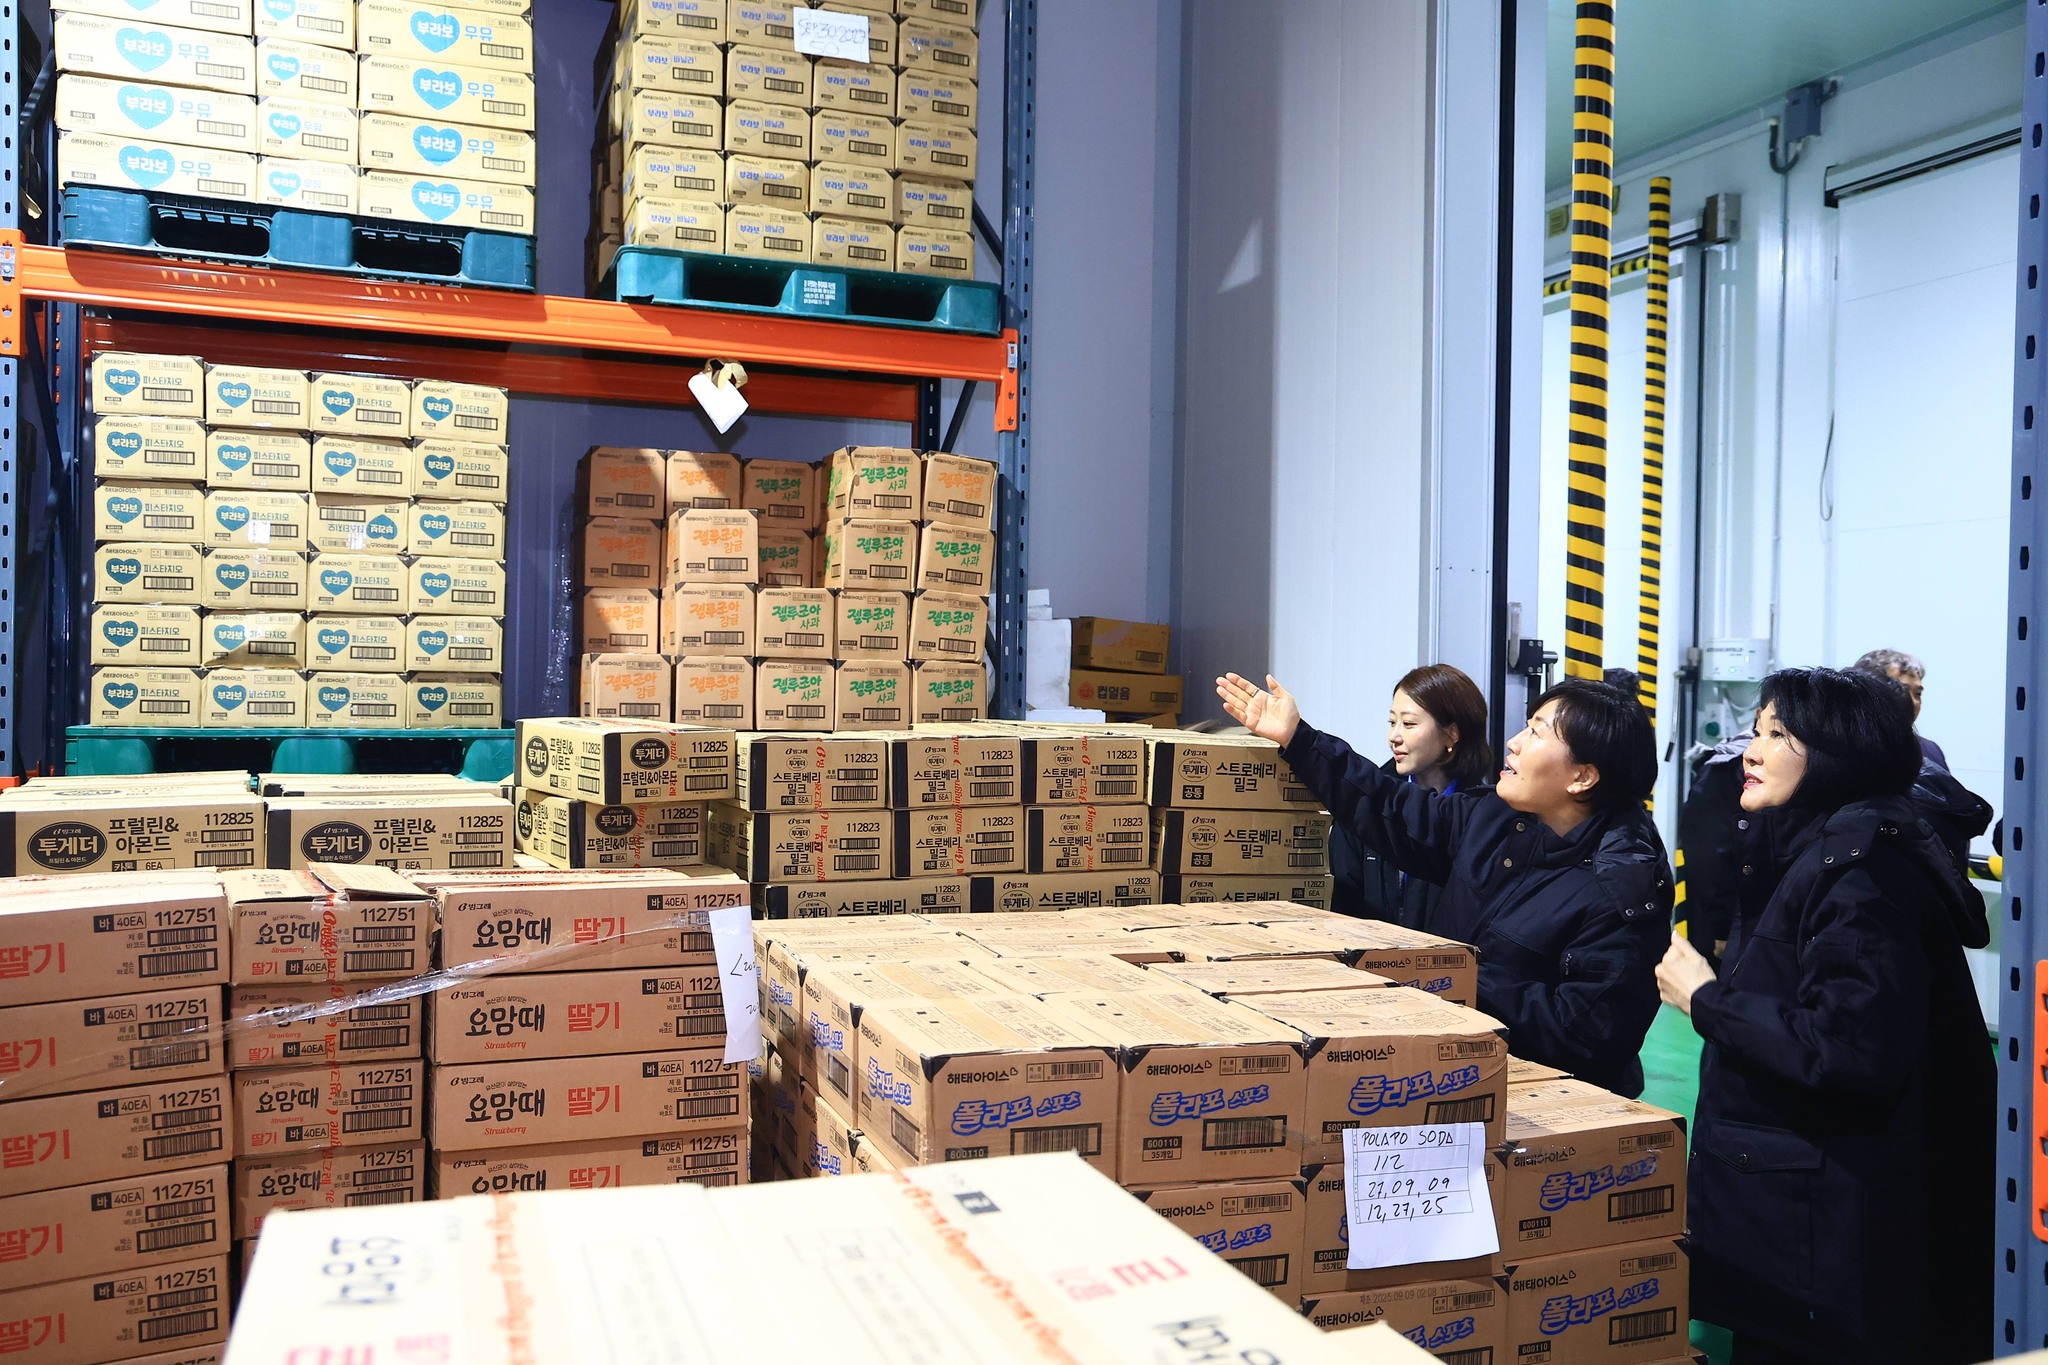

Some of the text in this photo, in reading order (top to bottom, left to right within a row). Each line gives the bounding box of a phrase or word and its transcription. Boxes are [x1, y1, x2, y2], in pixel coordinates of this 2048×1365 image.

[124, 37, 210, 60] 부라보 우유
[419, 78, 495, 99] 부라보 우유
[419, 134, 495, 155] 부라보 우유
[127, 155, 212, 177] 부라보 우유
[418, 190, 493, 210] 부라보 우유
[109, 375, 136, 386] 부라보
[326, 396, 351, 407] 부라보
[428, 460, 451, 471] 부라보
[111, 564, 137, 575] 부라보
[325, 576, 348, 586] 부라보
[107, 689, 134, 699] 부라보
[635, 747, 666, 759] 투게더
[691, 741, 728, 753] 112825
[844, 753, 878, 763] 112823
[981, 750, 1013, 760] 112823
[1106, 750, 1138, 760] 112823
[1182, 764, 1208, 775] 투게더
[1215, 762, 1277, 778] 스트로베리
[787, 784, 807, 795] 밀크
[928, 780, 947, 791] 밀크
[1055, 778, 1073, 789] 밀크
[1234, 777, 1258, 792] 밀크
[1183, 786, 1202, 798] 공통
[204, 812, 254, 826] 112825
[601, 814, 633, 826] 투게더
[661, 807, 699, 820] 112825
[108, 816, 180, 835] 프럴린&
[373, 818, 436, 835] 프럴린&
[459, 816, 504, 828] 112825
[846, 823, 880, 832] 112823
[982, 817, 1014, 826] 112823
[1113, 818, 1143, 827] 112823
[116, 836, 172, 854] 아몬드
[379, 836, 429, 854] 아몬드
[1049, 836, 1092, 847] 스트로베리
[1191, 832, 1216, 843] 투게더
[1223, 830, 1282, 845] 스트로베리
[38, 835, 98, 856] 투게더
[310, 836, 365, 855] 투게더
[1062, 847, 1080, 858] 밀크
[1241, 845, 1264, 859] 밀크
[790, 853, 810, 864] 밀크
[1192, 854, 1211, 865] 공통
[1126, 877, 1151, 886] 112823
[934, 885, 961, 894] 112823
[664, 893, 743, 908] 40EA 112751
[1038, 890, 1101, 907] 스트로베리
[360, 907, 415, 922] 112751
[836, 899, 907, 915] 스트로베리
[116, 907, 216, 927] 40EA 112751
[255, 921, 320, 945] 요맘때
[472, 917, 626, 948] 요맘때 딸기
[252, 961, 327, 975] 딸기 40EA
[107, 998, 208, 1020] 40EA 112751
[465, 1002, 620, 1036] 요맘때 딸기
[484, 1040, 526, 1050] Strawberry
[1327, 1048, 1389, 1063] 해태아이스
[358, 1068, 412, 1085] 112751
[1147, 1063, 1204, 1076] 해태아이스
[947, 1071, 1010, 1085] 해태아이스
[1348, 1065, 1479, 1116] 폴라포 스포츠
[121, 1087, 220, 1111] 40EA 112751
[255, 1087, 319, 1113] 요맘때
[465, 1085, 620, 1122] 요맘때 딸기
[1149, 1084, 1269, 1127] 폴라포 스포츠
[951, 1091, 1082, 1136] 폴라포 스포츠
[251, 1127, 326, 1147] 딸기 40EA
[484, 1126, 526, 1136] Strawberry
[660, 1135, 737, 1152] 40EA 112751
[1147, 1138, 1178, 1148] 600110
[1361, 1131, 1454, 1147] POLAPO SODA
[360, 1150, 413, 1167] 112751
[950, 1150, 985, 1159] 600110
[1374, 1154, 1405, 1172] 112
[114, 1178, 214, 1204] 40EA 112751
[258, 1170, 321, 1197] 요맘때
[1539, 1156, 1657, 1212] 폴라포 스포츠
[1522, 1218, 1548, 1230] 600110
[1318, 1251, 1347, 1261] 600110
[116, 1266, 216, 1293] 40EA 112751
[1513, 1274, 1569, 1292] 해태아이스
[1539, 1278, 1659, 1336] 폴라포 스포츠
[1314, 1310, 1375, 1328] 해태아이스
[1522, 1342, 1548, 1354] 600110
